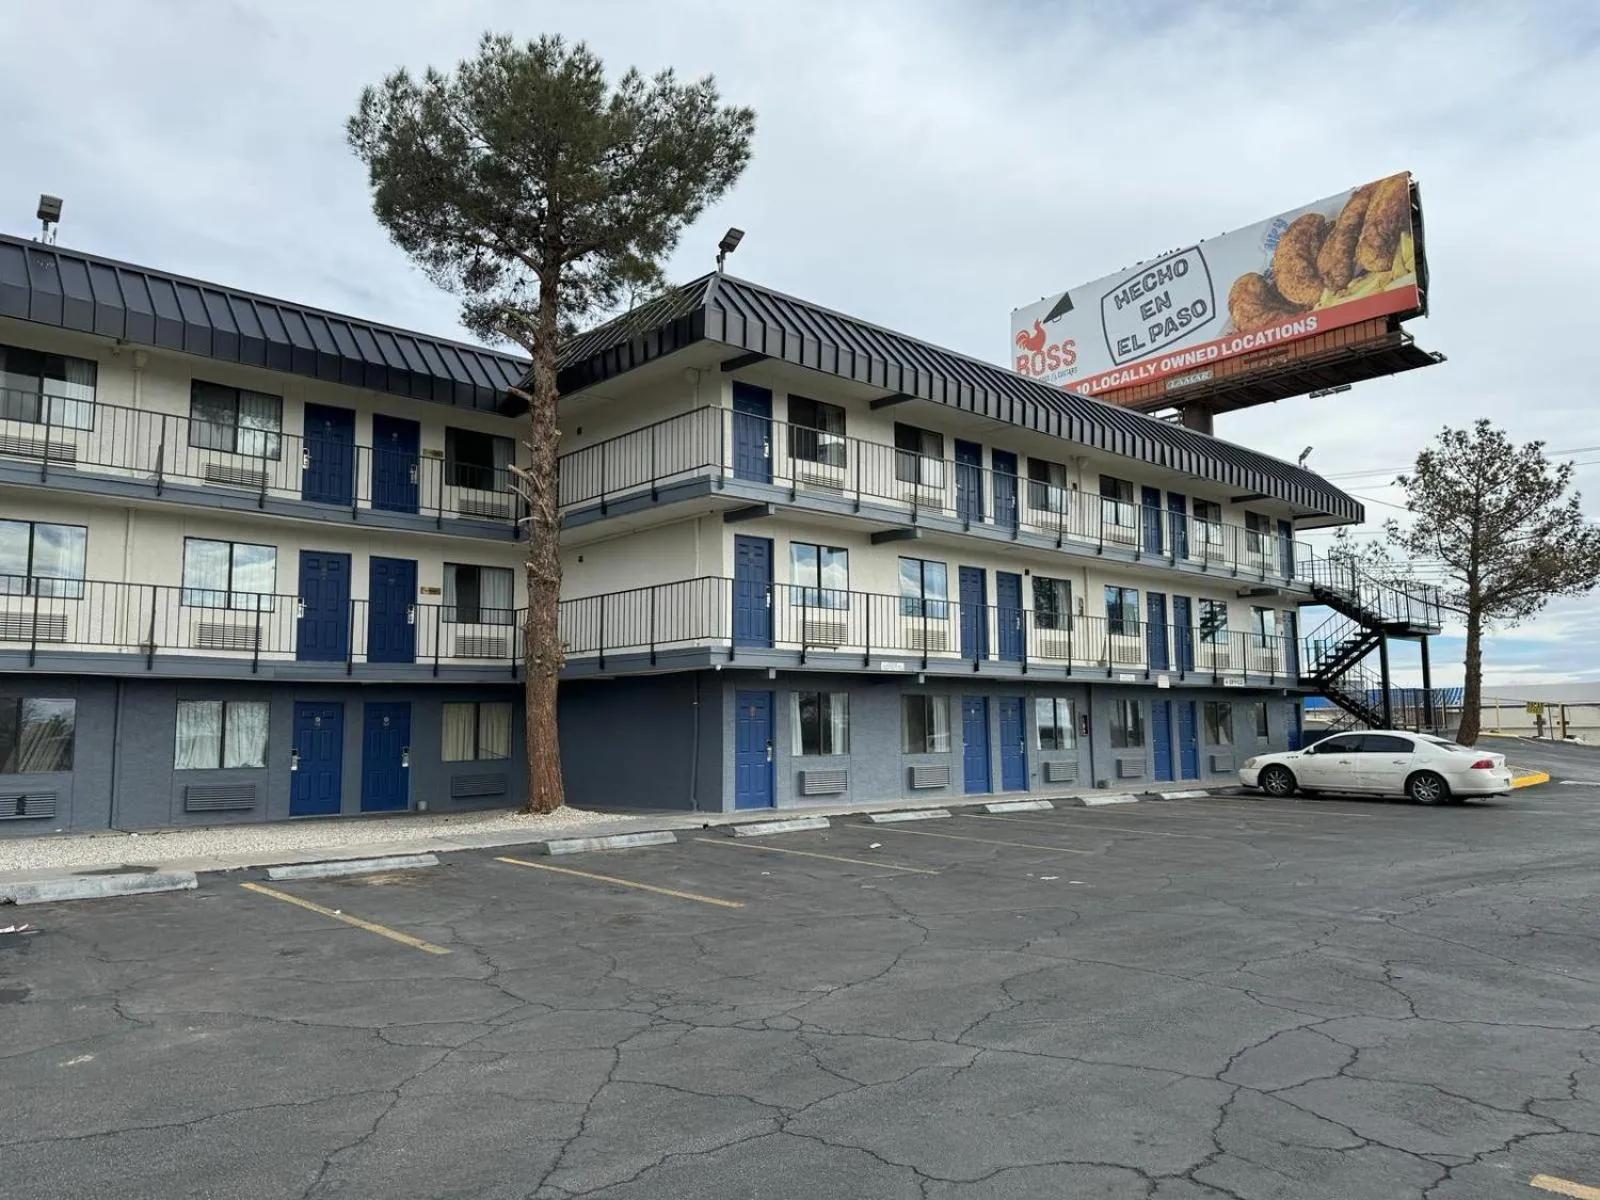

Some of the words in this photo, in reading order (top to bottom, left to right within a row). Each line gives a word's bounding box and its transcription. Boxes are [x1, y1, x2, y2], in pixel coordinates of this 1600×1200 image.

[1114, 258, 1189, 310] HECHO
[1139, 290, 1172, 321] EN
[1117, 334, 1146, 356] EL
[1148, 299, 1207, 343] PASO
[1076, 382, 1090, 395] 10
[1092, 362, 1158, 391] LOCALLY
[1160, 347, 1218, 371] OWNED
[1222, 316, 1318, 355] LOCATIONS
